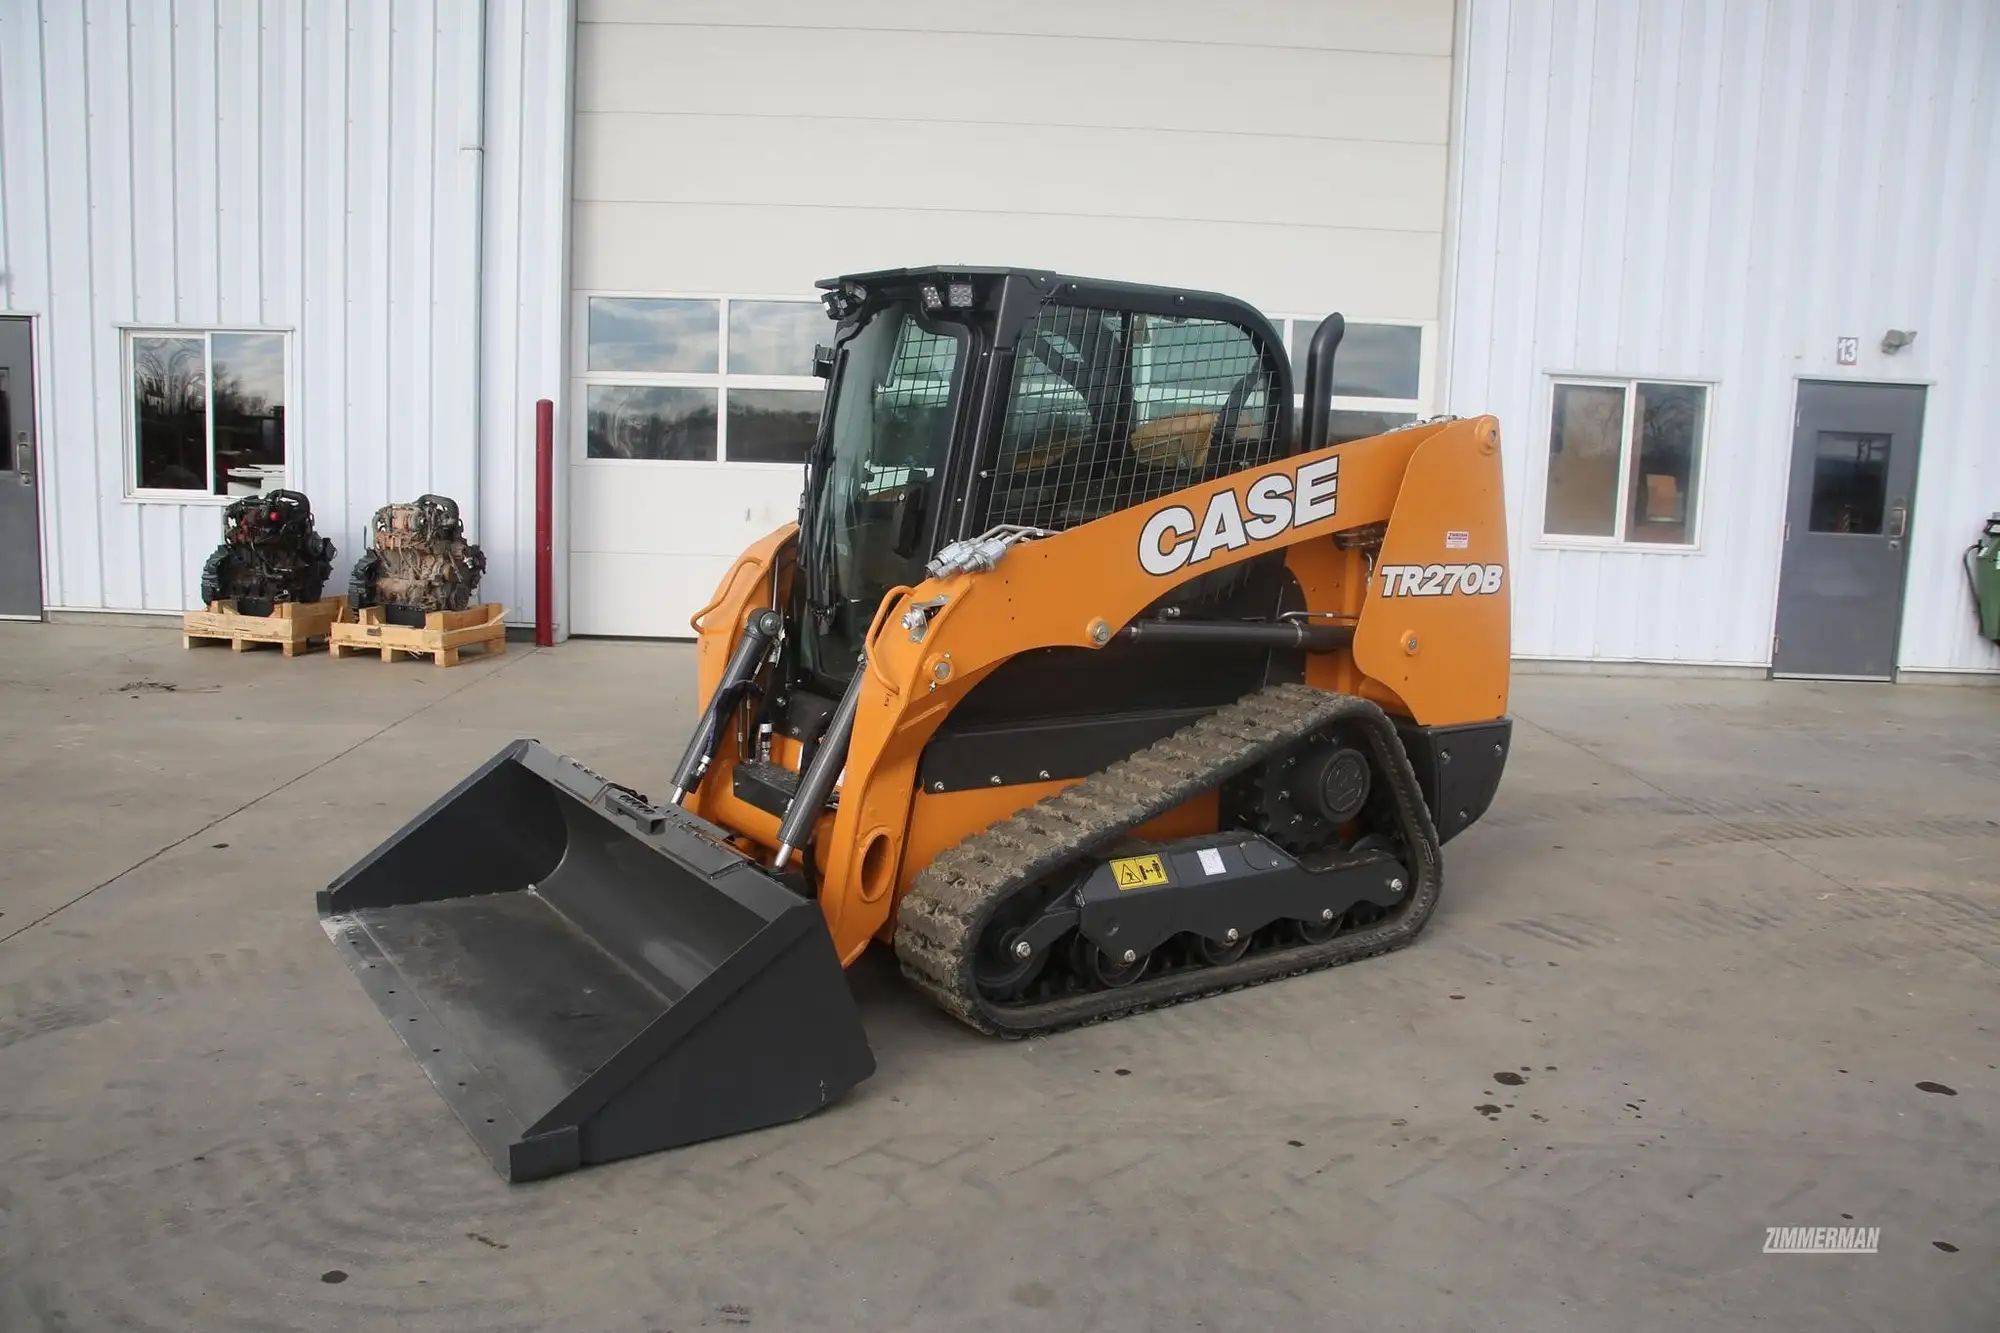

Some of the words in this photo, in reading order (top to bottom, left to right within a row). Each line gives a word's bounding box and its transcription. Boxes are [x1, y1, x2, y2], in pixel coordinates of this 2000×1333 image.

[1838, 338, 1857, 362] 13
[1138, 454, 1340, 576] CASE
[1380, 562, 1504, 598] TR270B
